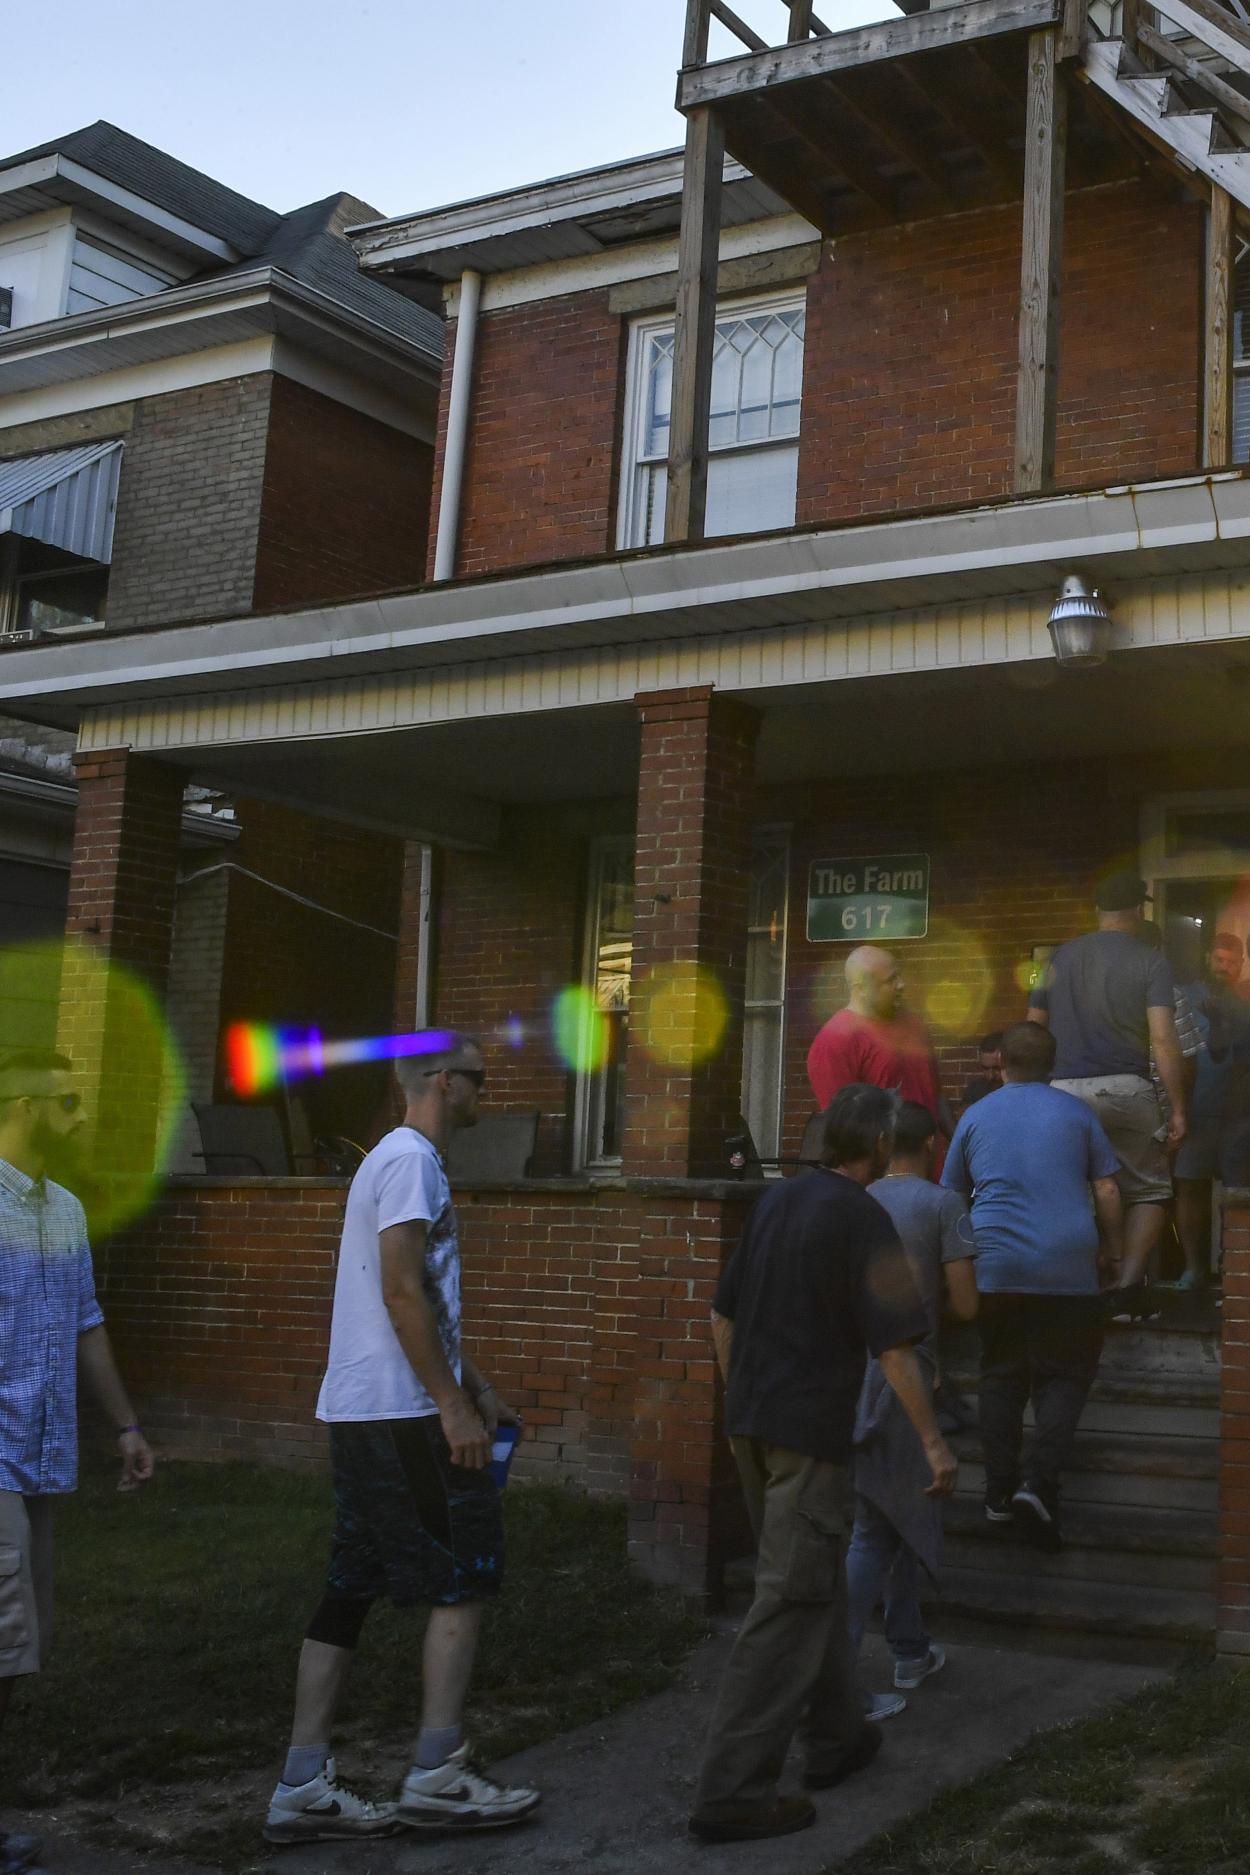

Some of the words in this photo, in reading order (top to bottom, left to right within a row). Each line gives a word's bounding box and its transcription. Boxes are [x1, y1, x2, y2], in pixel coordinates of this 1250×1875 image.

[815, 868, 857, 894] The
[863, 866, 923, 892] Farm
[841, 905, 892, 930] 617
